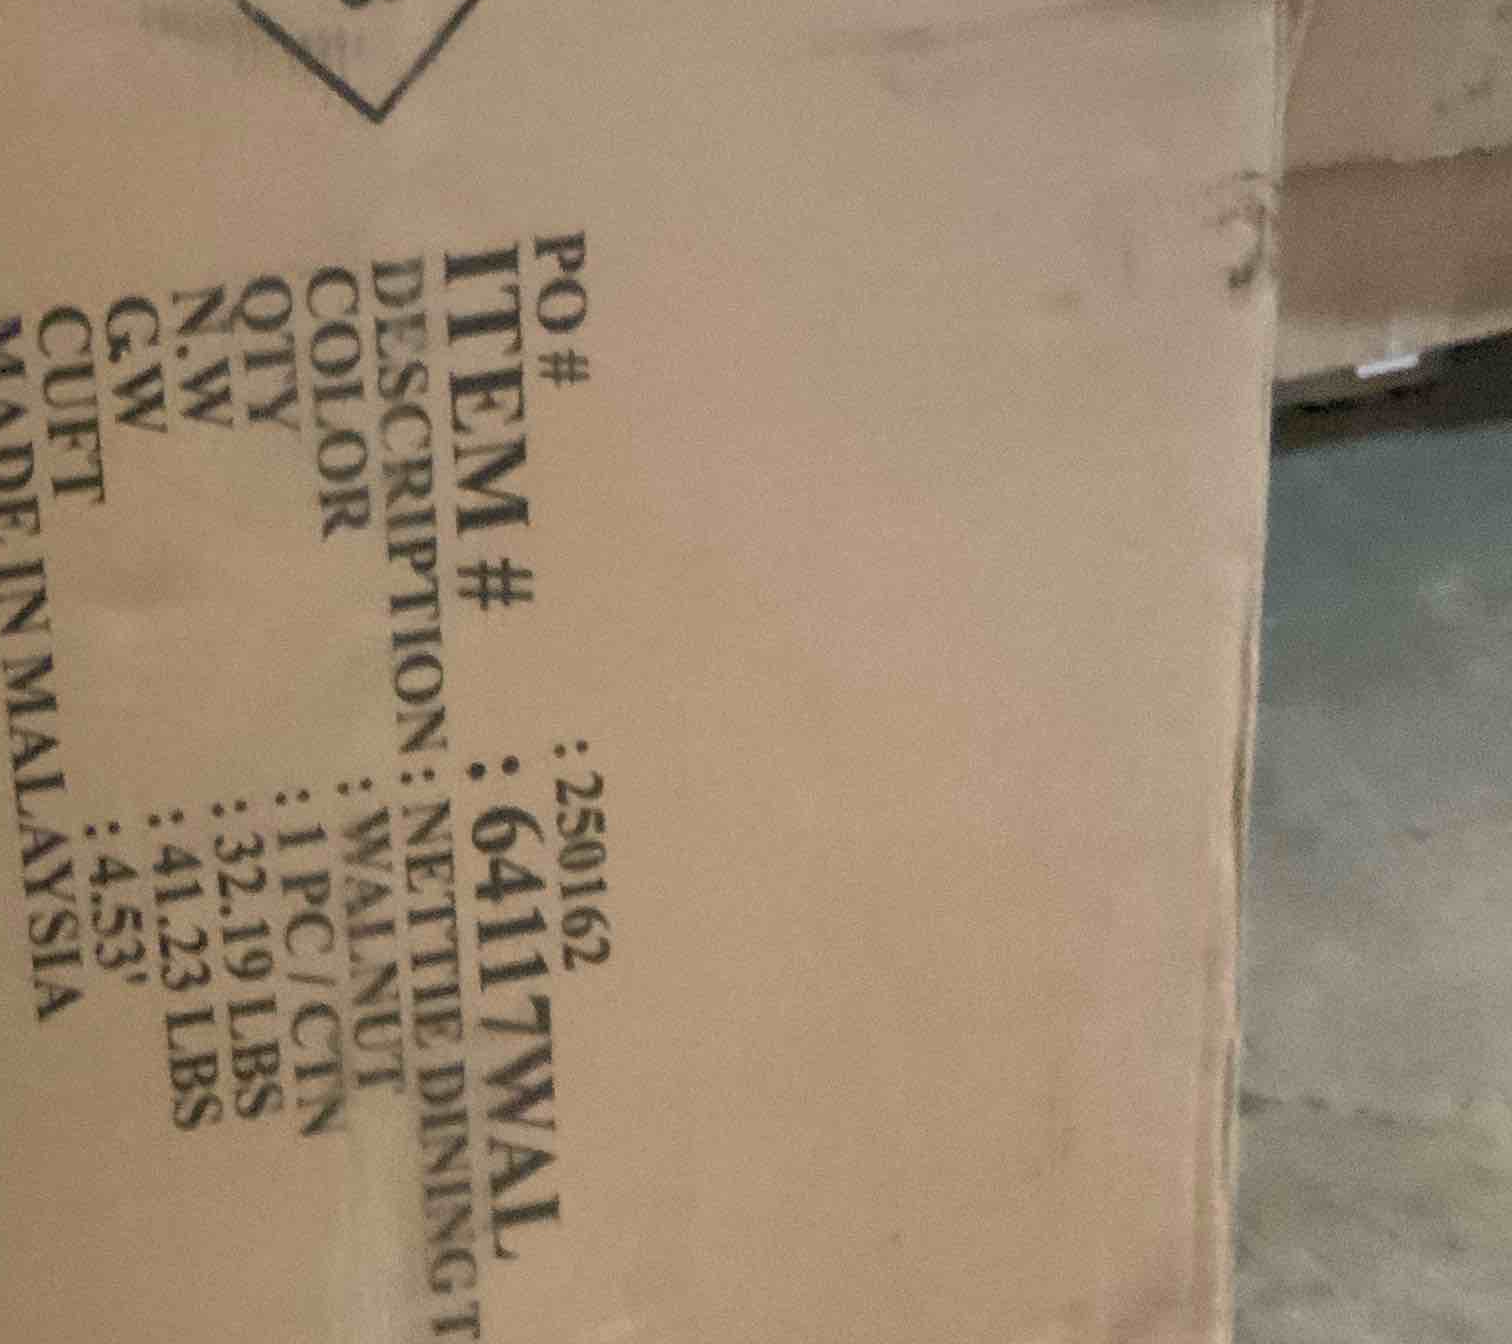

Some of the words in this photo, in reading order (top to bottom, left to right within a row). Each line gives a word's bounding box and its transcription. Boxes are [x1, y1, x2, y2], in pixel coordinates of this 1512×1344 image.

[37, 305, 106, 504] CUFT
[236, 274, 299, 431] QTY
[306, 266, 371, 540] COLOR
[443, 241, 530, 537] ITEM
[456, 557, 534, 612] #
[171, 284, 237, 428] N.W
[228, 998, 284, 1120] LBS
[1, 653, 83, 1023] MALAYSIA
[164, 1006, 223, 1131] LBS
[417, 1061, 478, 1295] DINING
